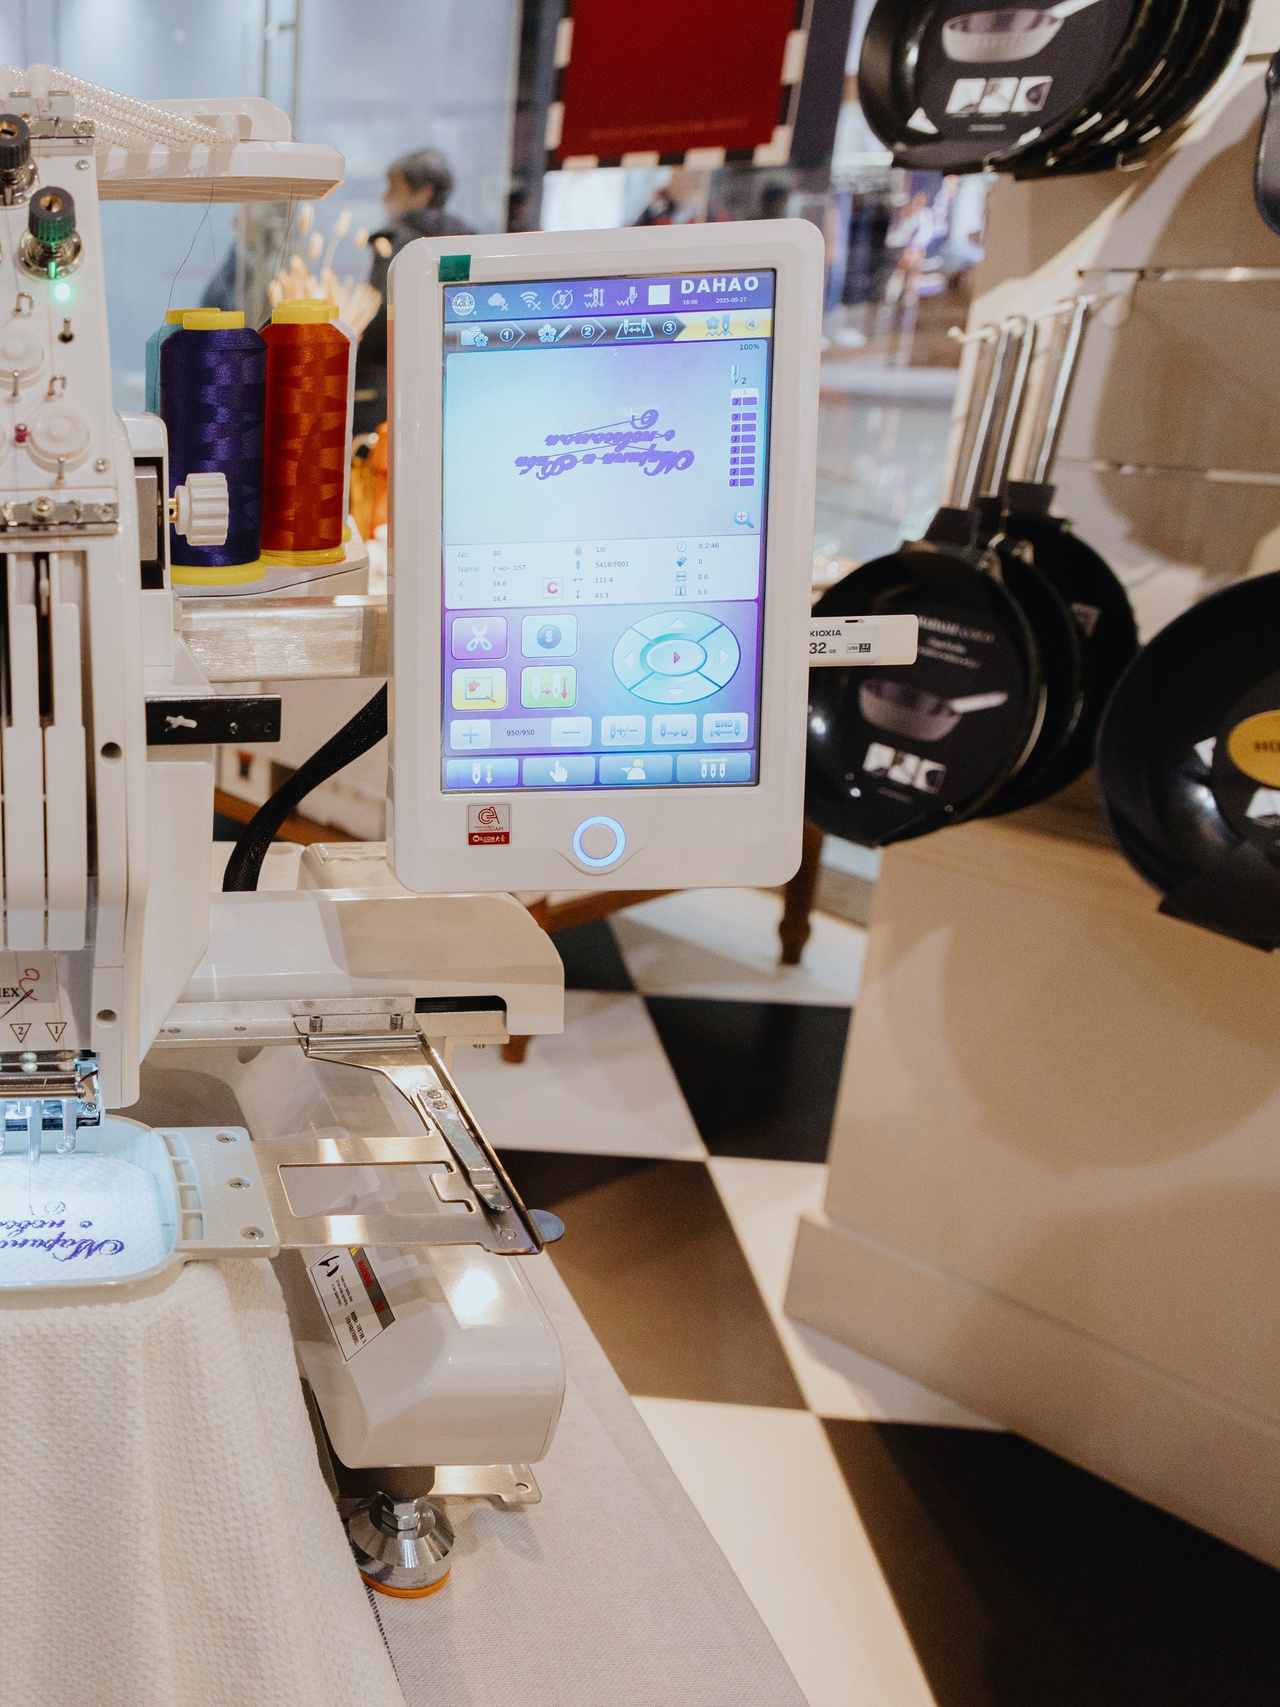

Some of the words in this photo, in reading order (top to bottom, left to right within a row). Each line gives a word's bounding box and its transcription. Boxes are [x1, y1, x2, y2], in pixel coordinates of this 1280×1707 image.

[680, 276, 759, 294] DAHAO
[682, 298, 699, 306] 16:00
[715, 296, 747, 304] 2025-09-27
[739, 343, 760, 351] 100%
[741, 377, 747, 385] 2
[457, 565, 480, 573] Name
[546, 581, 559, 595] C
[809, 629, 842, 637] KIOXIA
[809, 642, 827, 654] 32
[715, 720, 733, 728] END
[357, 1260, 373, 1288] WARNING
